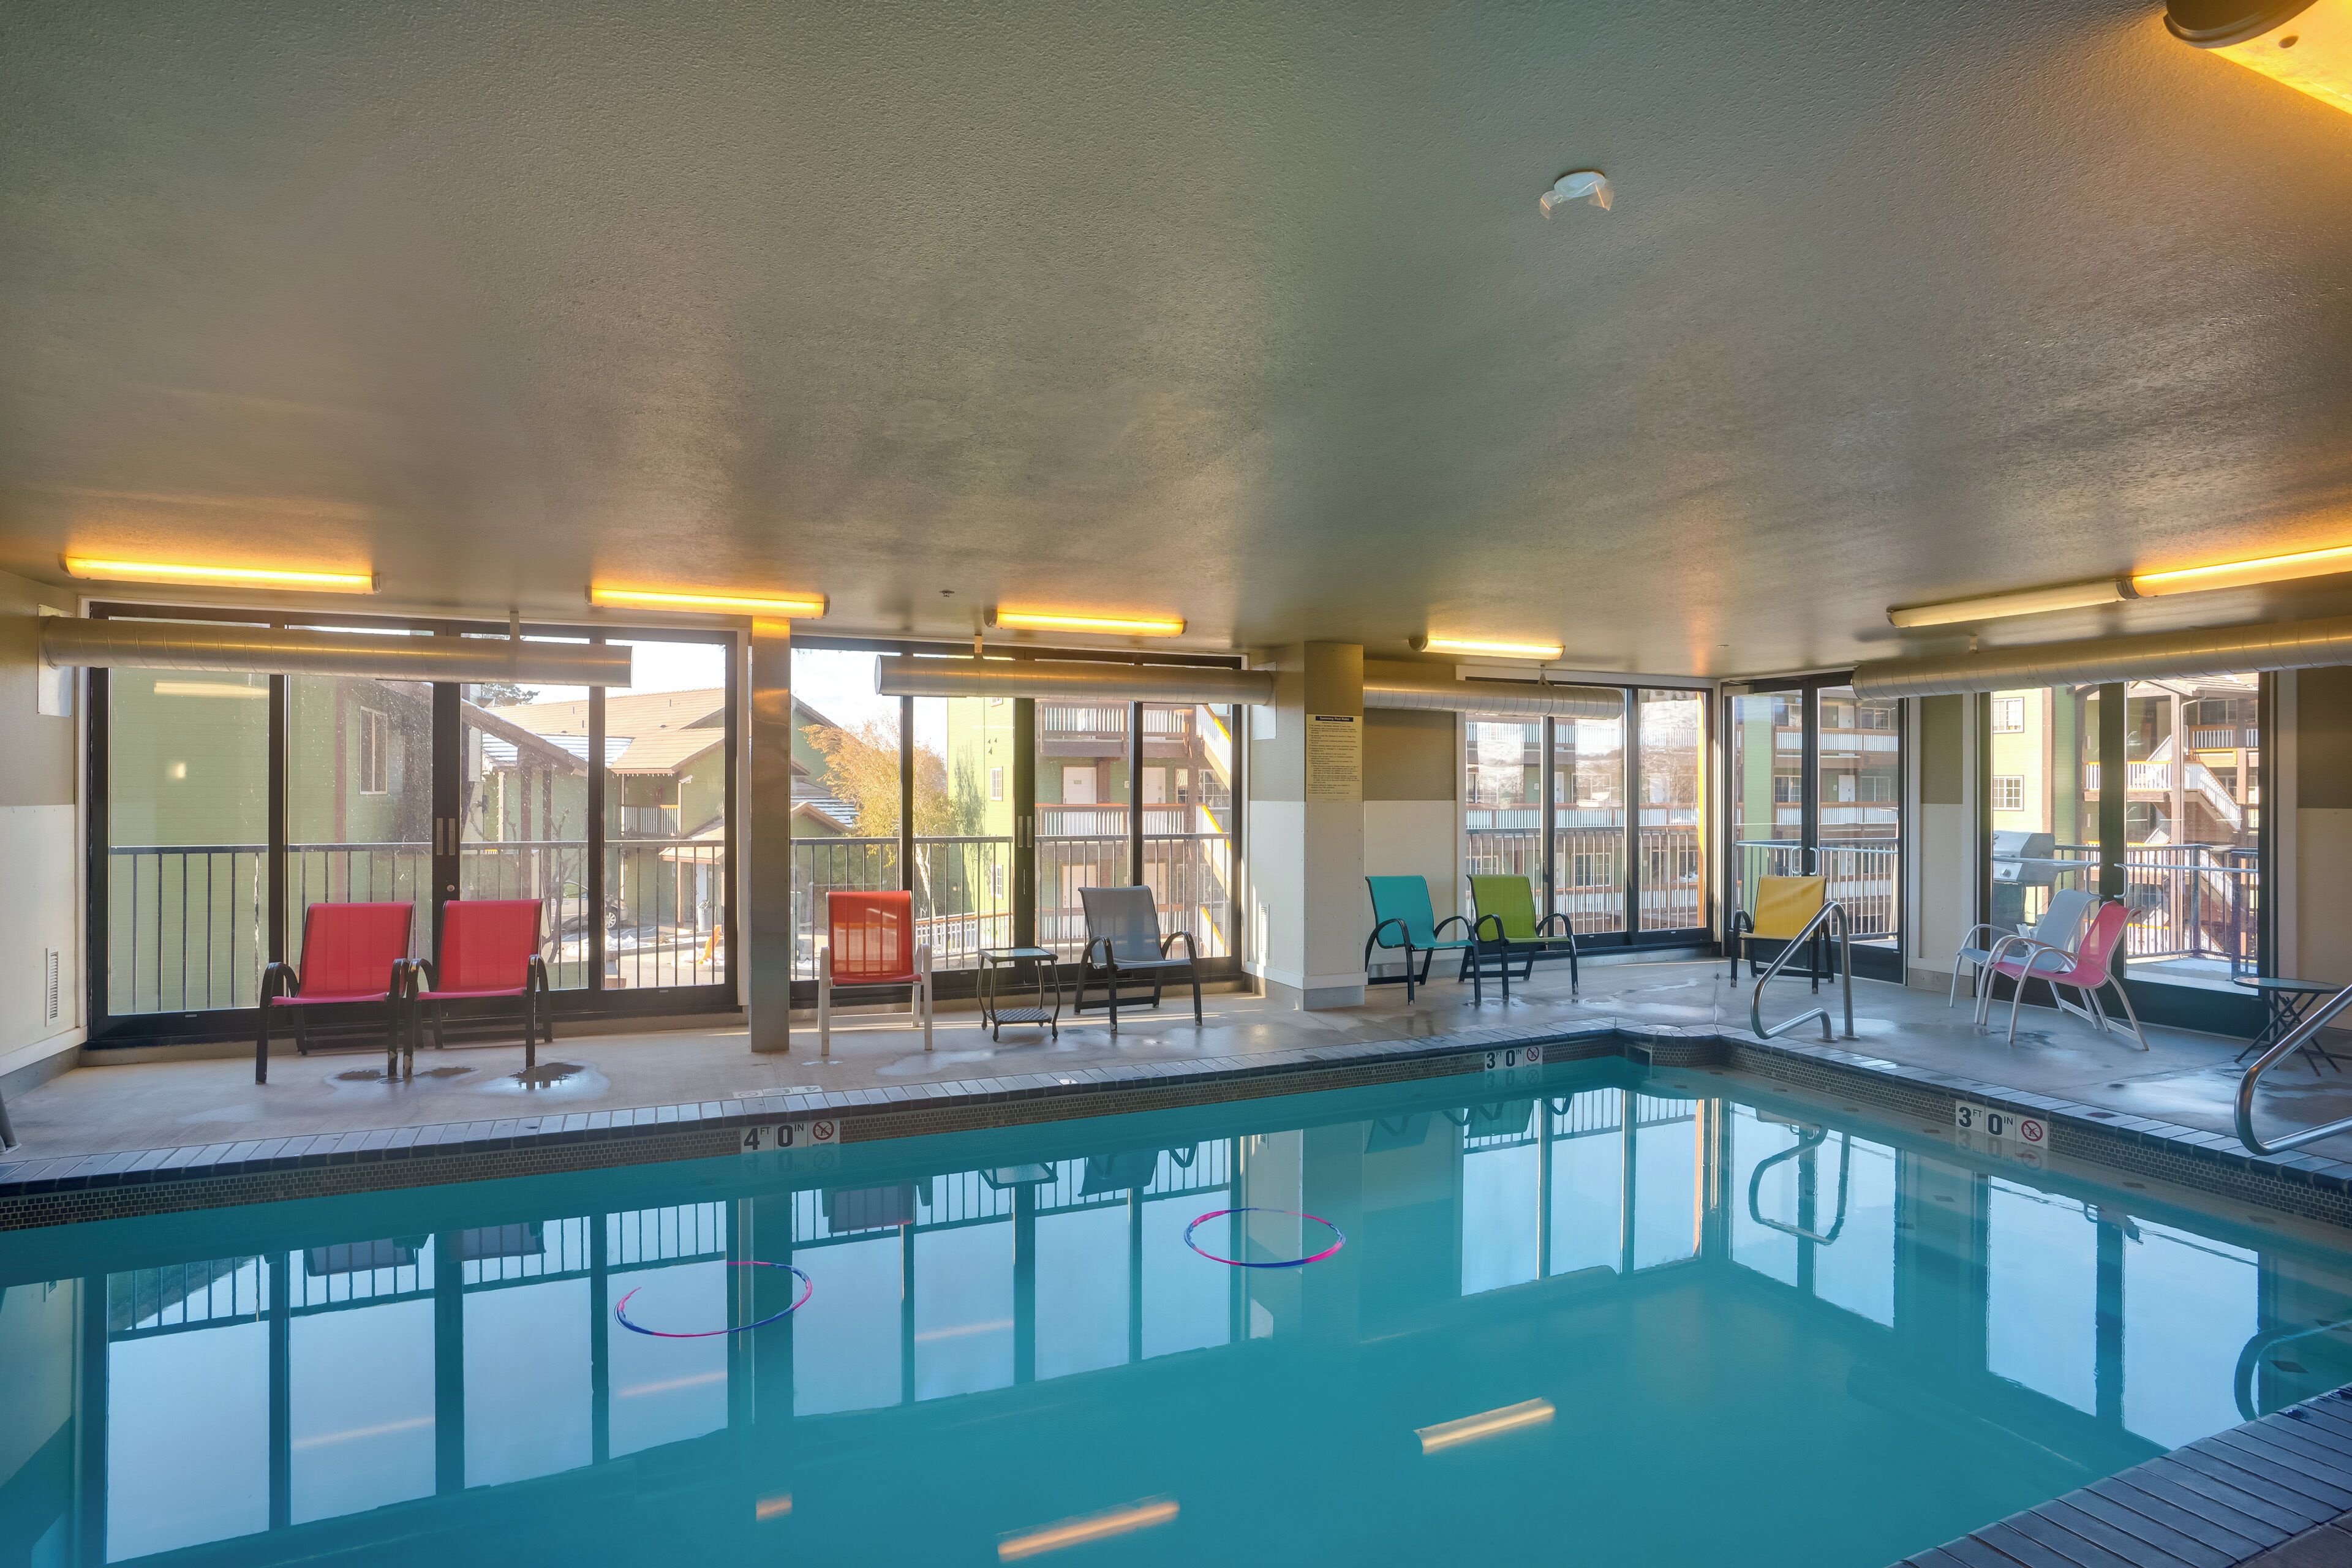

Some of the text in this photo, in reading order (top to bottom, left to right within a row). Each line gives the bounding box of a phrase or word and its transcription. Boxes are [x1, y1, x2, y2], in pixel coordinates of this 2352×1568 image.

[1487, 1052, 1496, 1069] 3
[1506, 1050, 1515, 1066] 0
[1959, 1107, 2013, 1136] 3 FT 0 IN
[744, 1123, 804, 1150] 4 FT 0 IN
